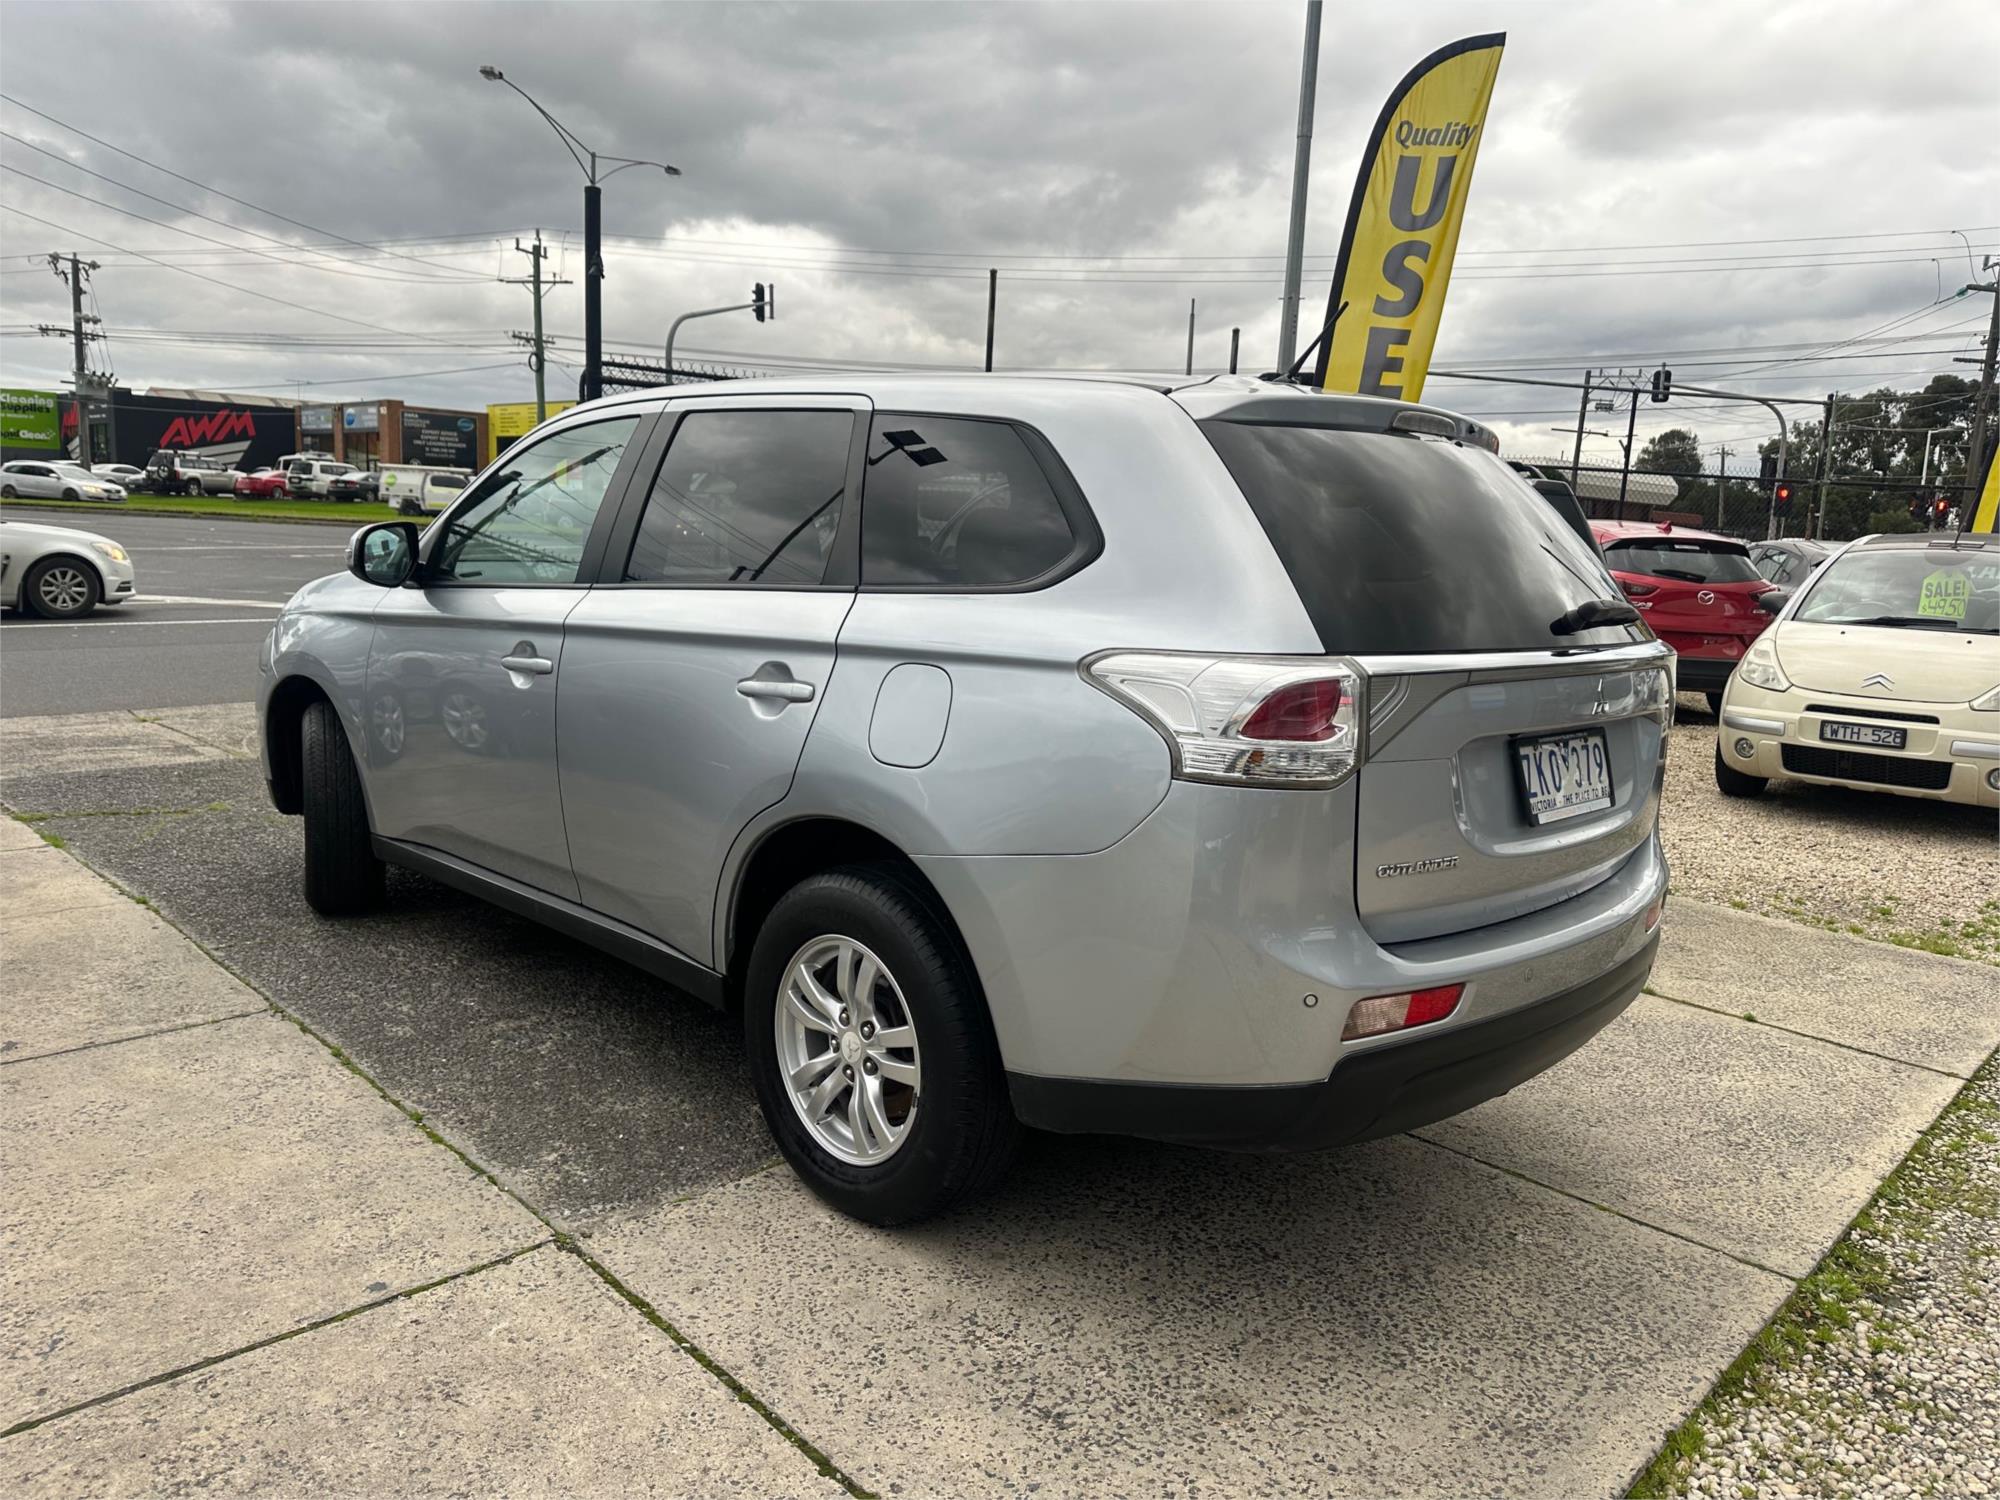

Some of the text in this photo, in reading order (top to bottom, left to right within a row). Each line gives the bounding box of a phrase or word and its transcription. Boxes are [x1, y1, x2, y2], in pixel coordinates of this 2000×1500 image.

[1395, 120, 1477, 150] Quality
[160, 408, 257, 449] AWM
[1925, 580, 1966, 599] SALE!
[1531, 797, 1558, 813] VICTORIA
[1563, 793, 1574, 806] THE
[1575, 789, 1591, 802] PLACE
[1592, 788, 1600, 798] TO
[1376, 855, 1460, 878] OUTLANDER
